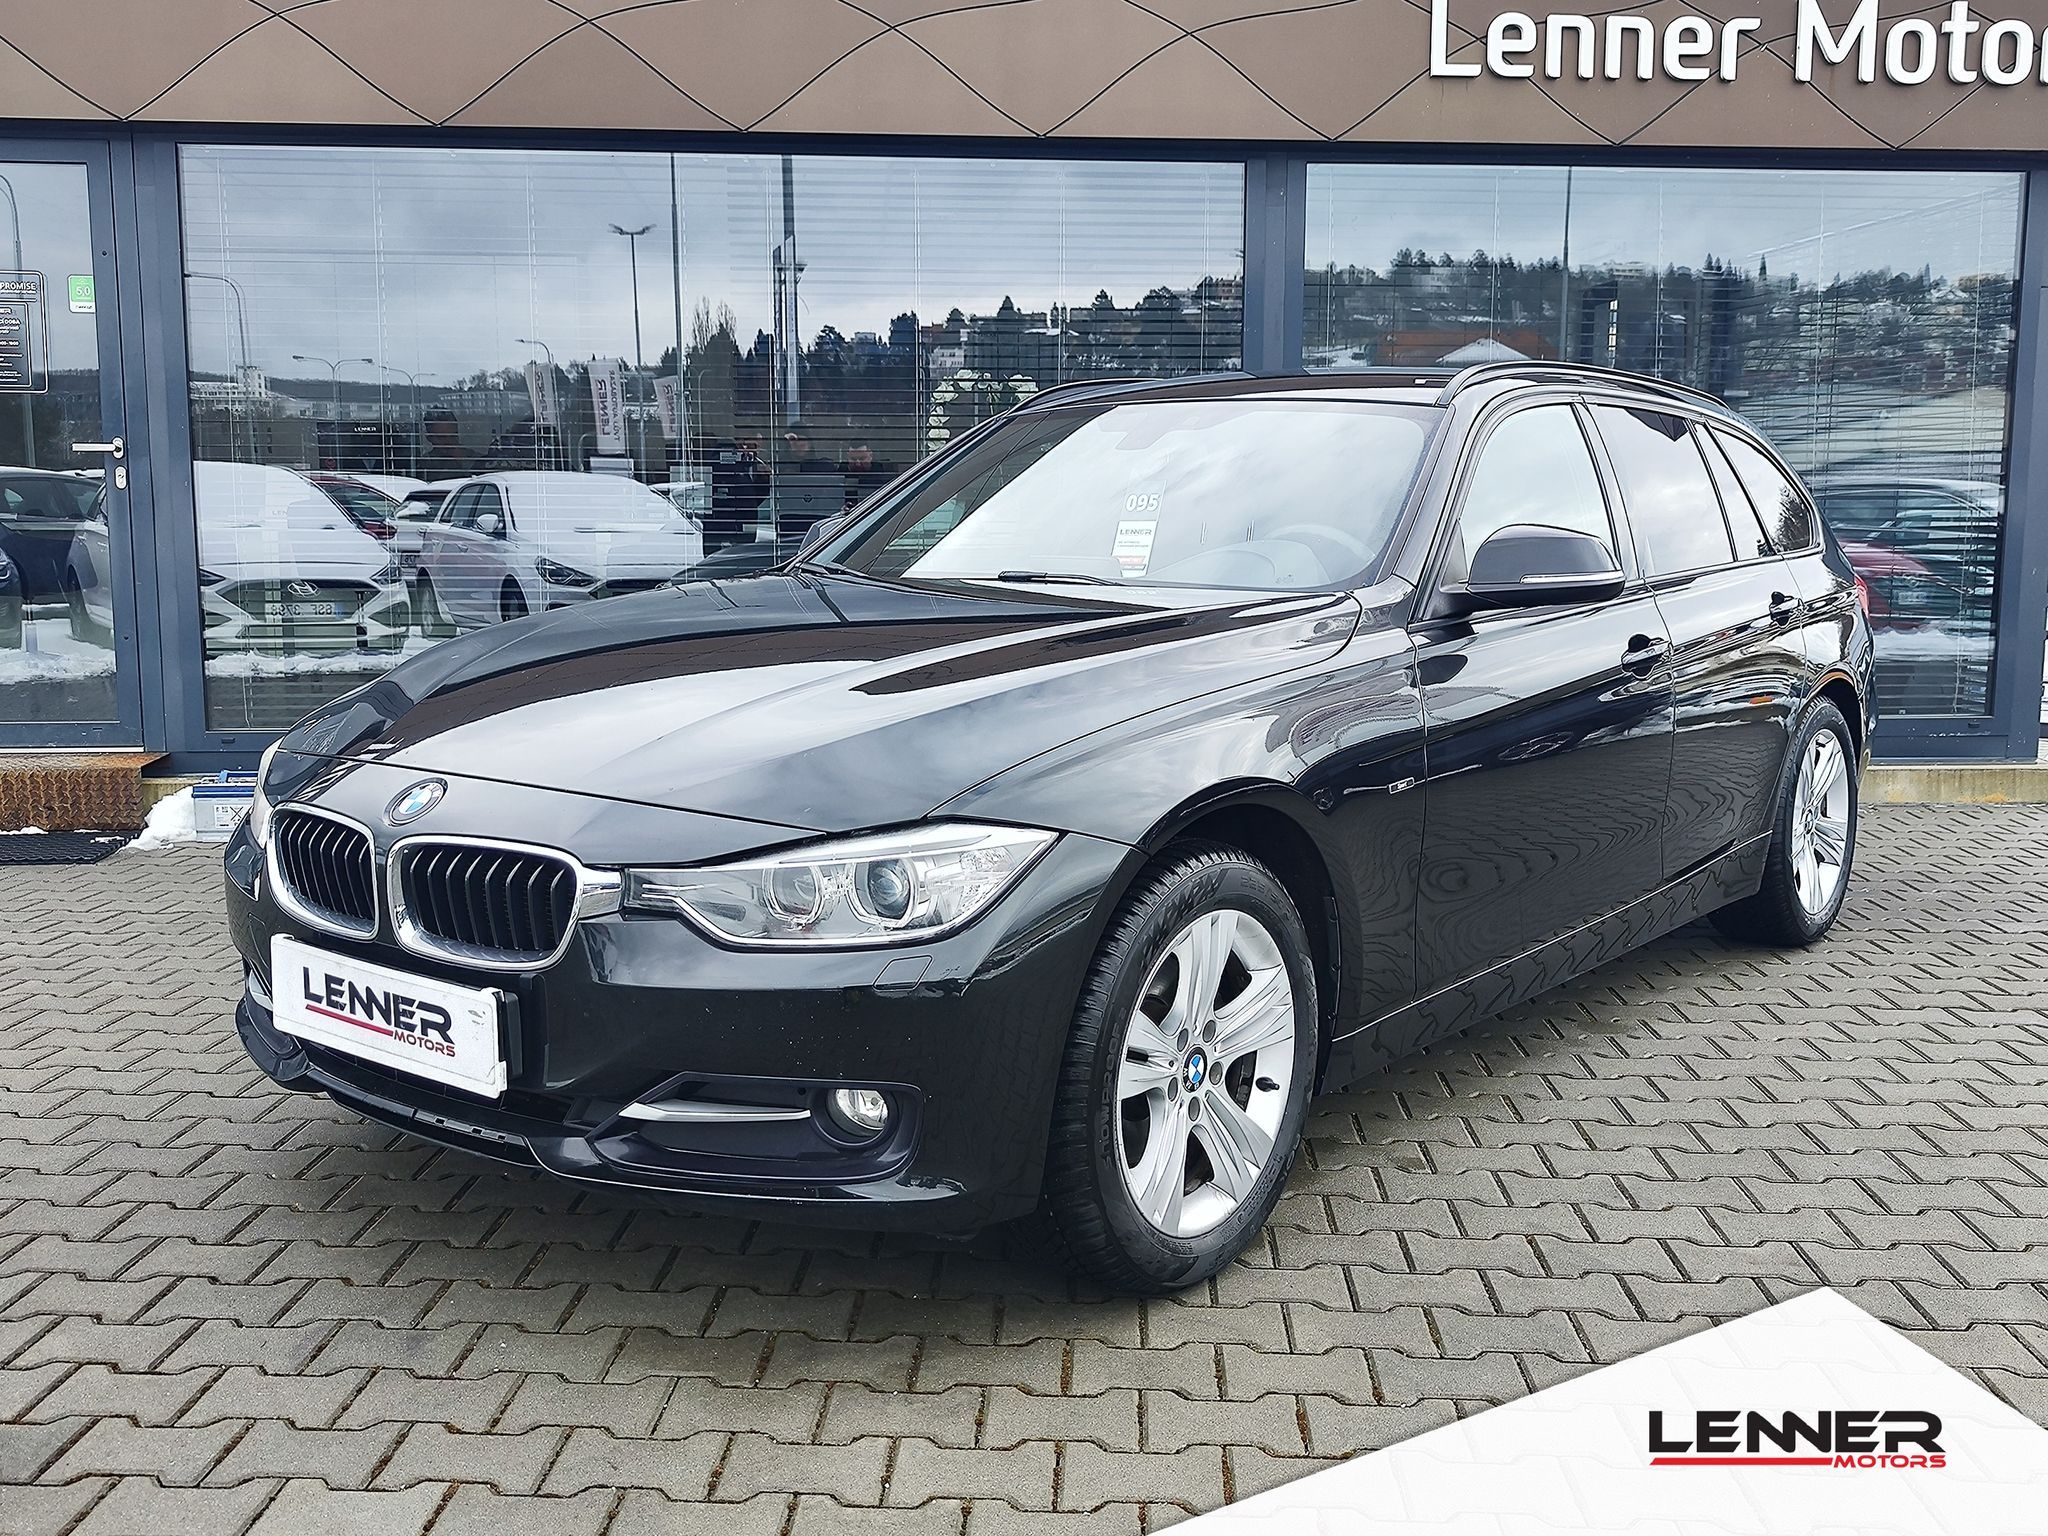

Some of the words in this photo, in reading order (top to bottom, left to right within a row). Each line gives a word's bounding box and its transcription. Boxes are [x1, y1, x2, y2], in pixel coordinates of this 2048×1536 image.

[1428, 0, 1763, 83] Lenner
[1795, 0, 2048, 86] Moto
[0, 282, 37, 290] PROMISE
[1125, 493, 1160, 512] 095
[302, 966, 455, 1045] LENNER
[394, 1030, 456, 1058] MOTORS
